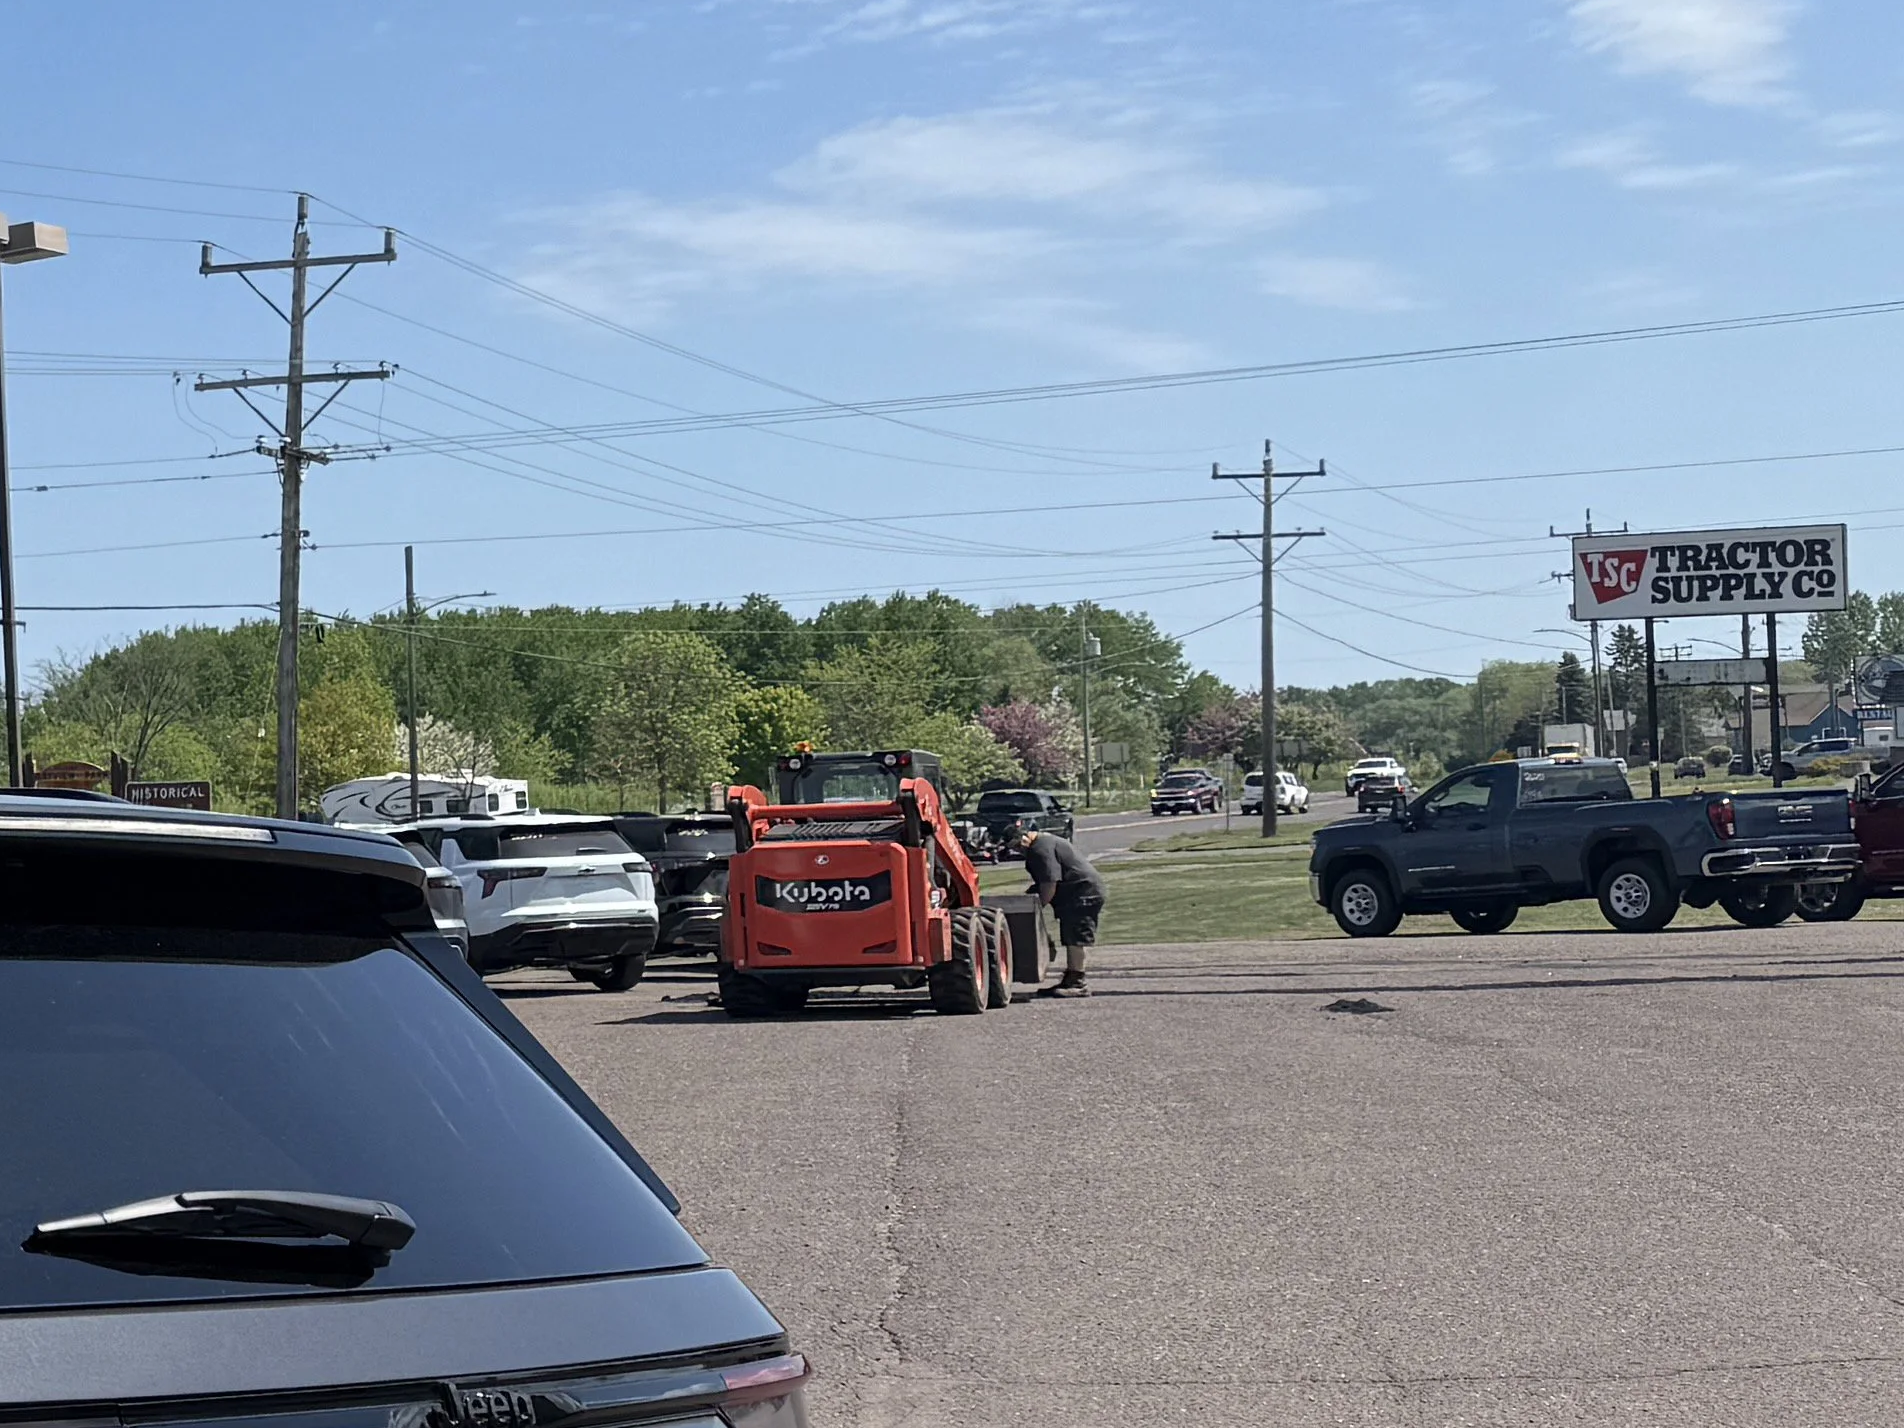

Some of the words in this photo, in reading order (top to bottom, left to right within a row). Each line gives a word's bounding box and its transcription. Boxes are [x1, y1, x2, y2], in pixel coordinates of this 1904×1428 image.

[1650, 538, 1834, 573] TRACTOR
[1586, 553, 1638, 593] TSC
[1650, 571, 1789, 604] SUPPLY
[131, 785, 206, 802] HISTORICAL
[775, 880, 871, 903] Kubota
